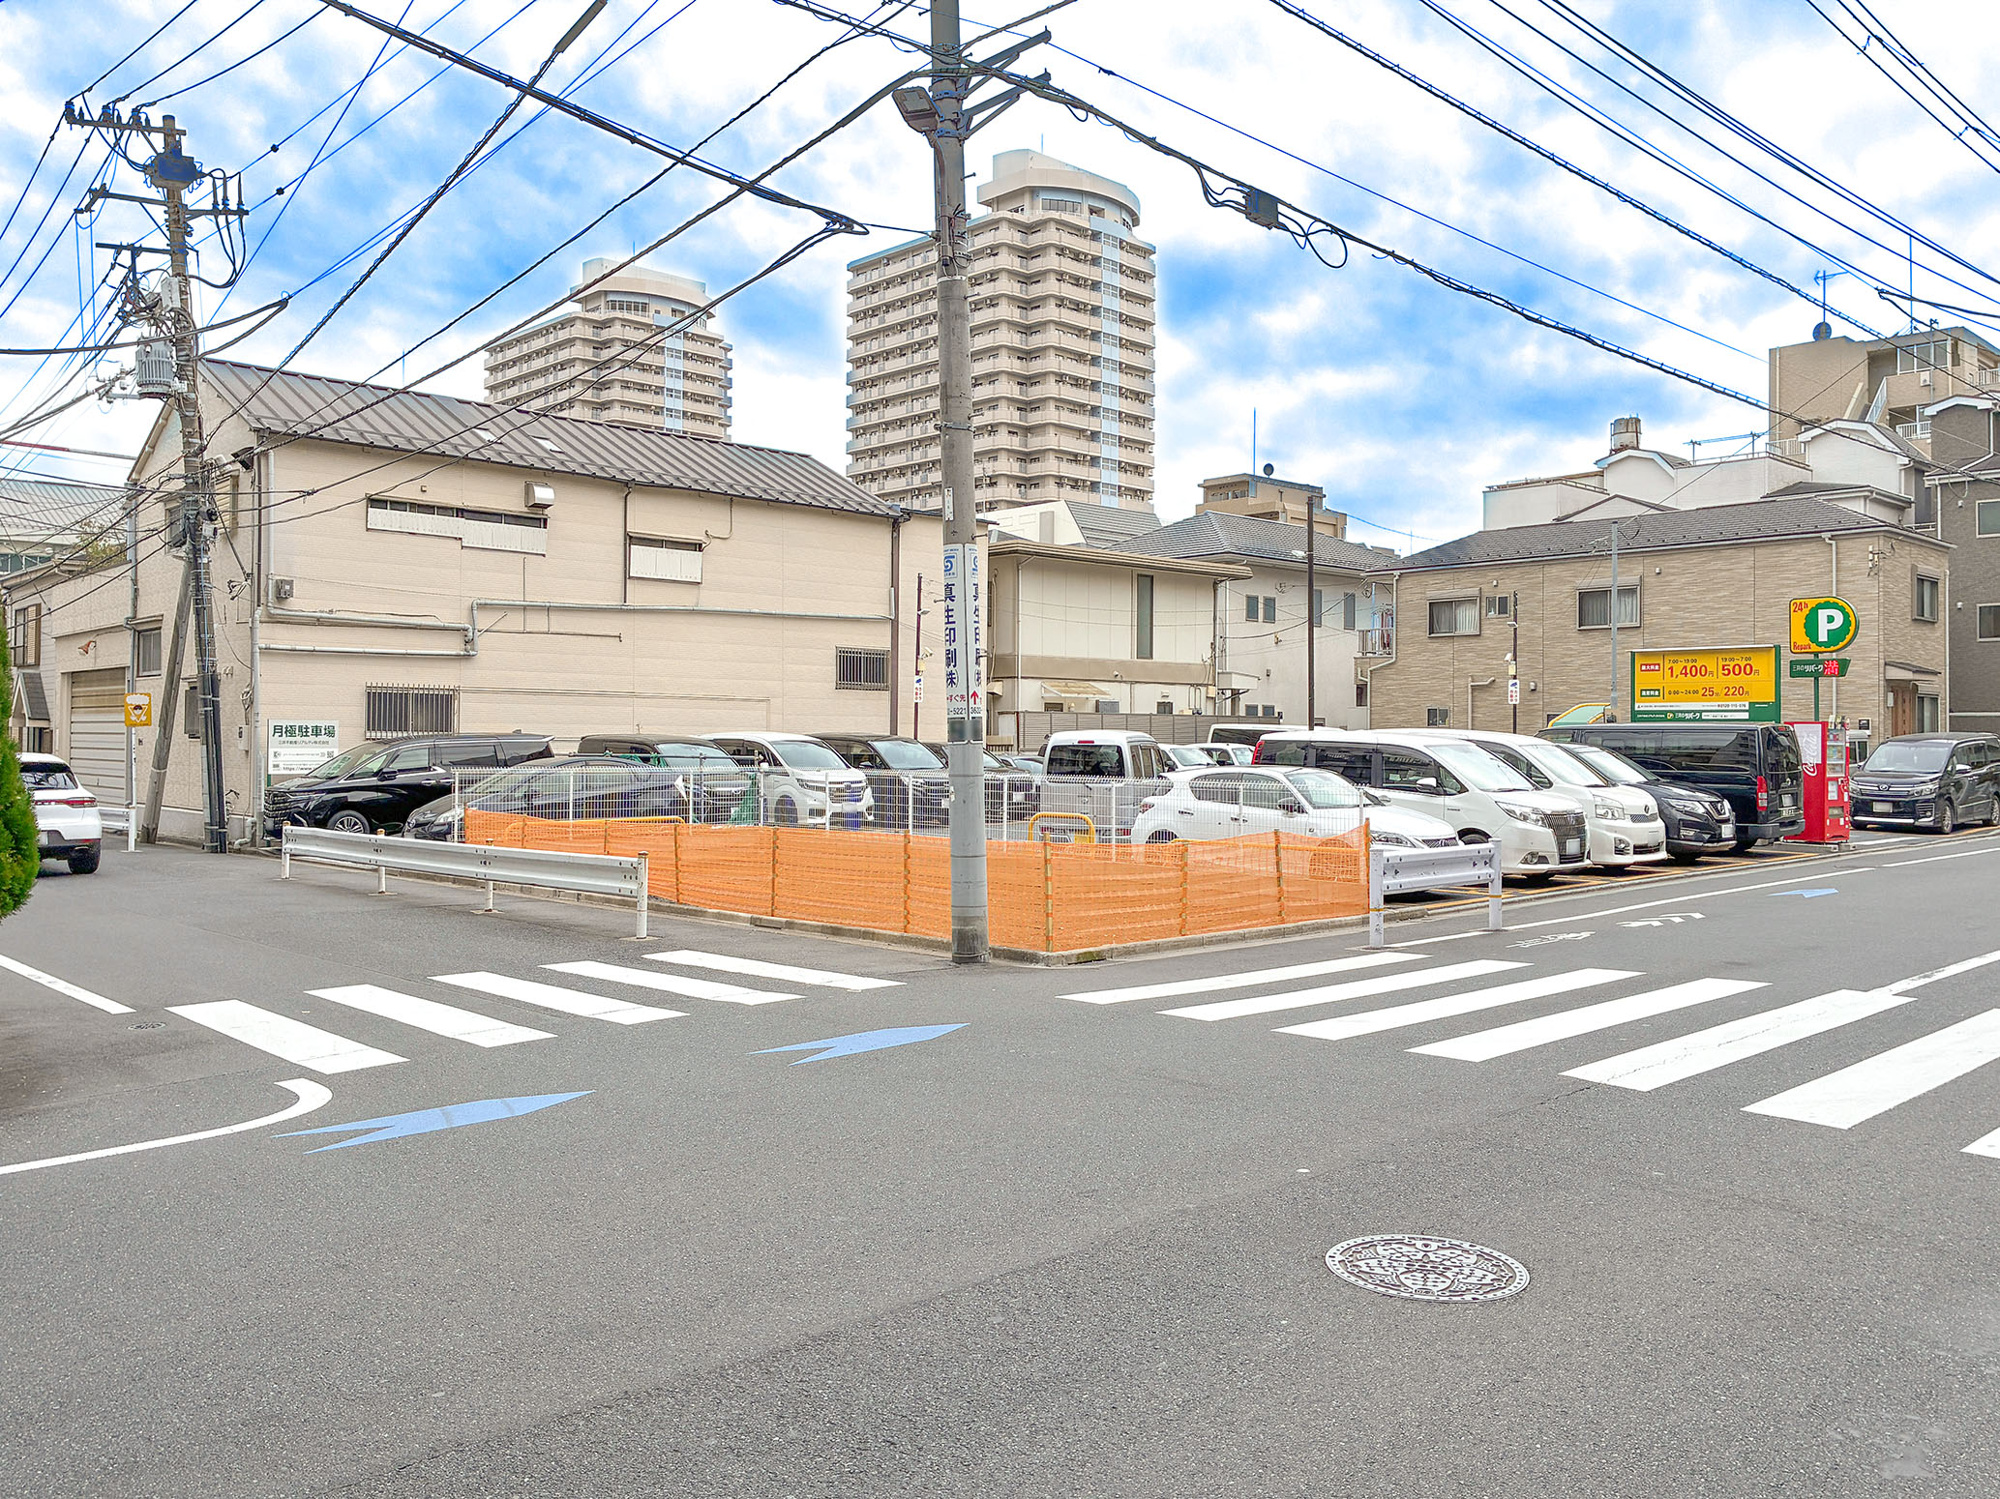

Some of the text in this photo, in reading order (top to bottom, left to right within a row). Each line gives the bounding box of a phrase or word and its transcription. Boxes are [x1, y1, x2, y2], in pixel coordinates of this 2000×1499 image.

[944, 582, 959, 688] 真生印刷株)
[1818, 608, 1844, 642] P
[272, 725, 336, 738] 月極駐車場
